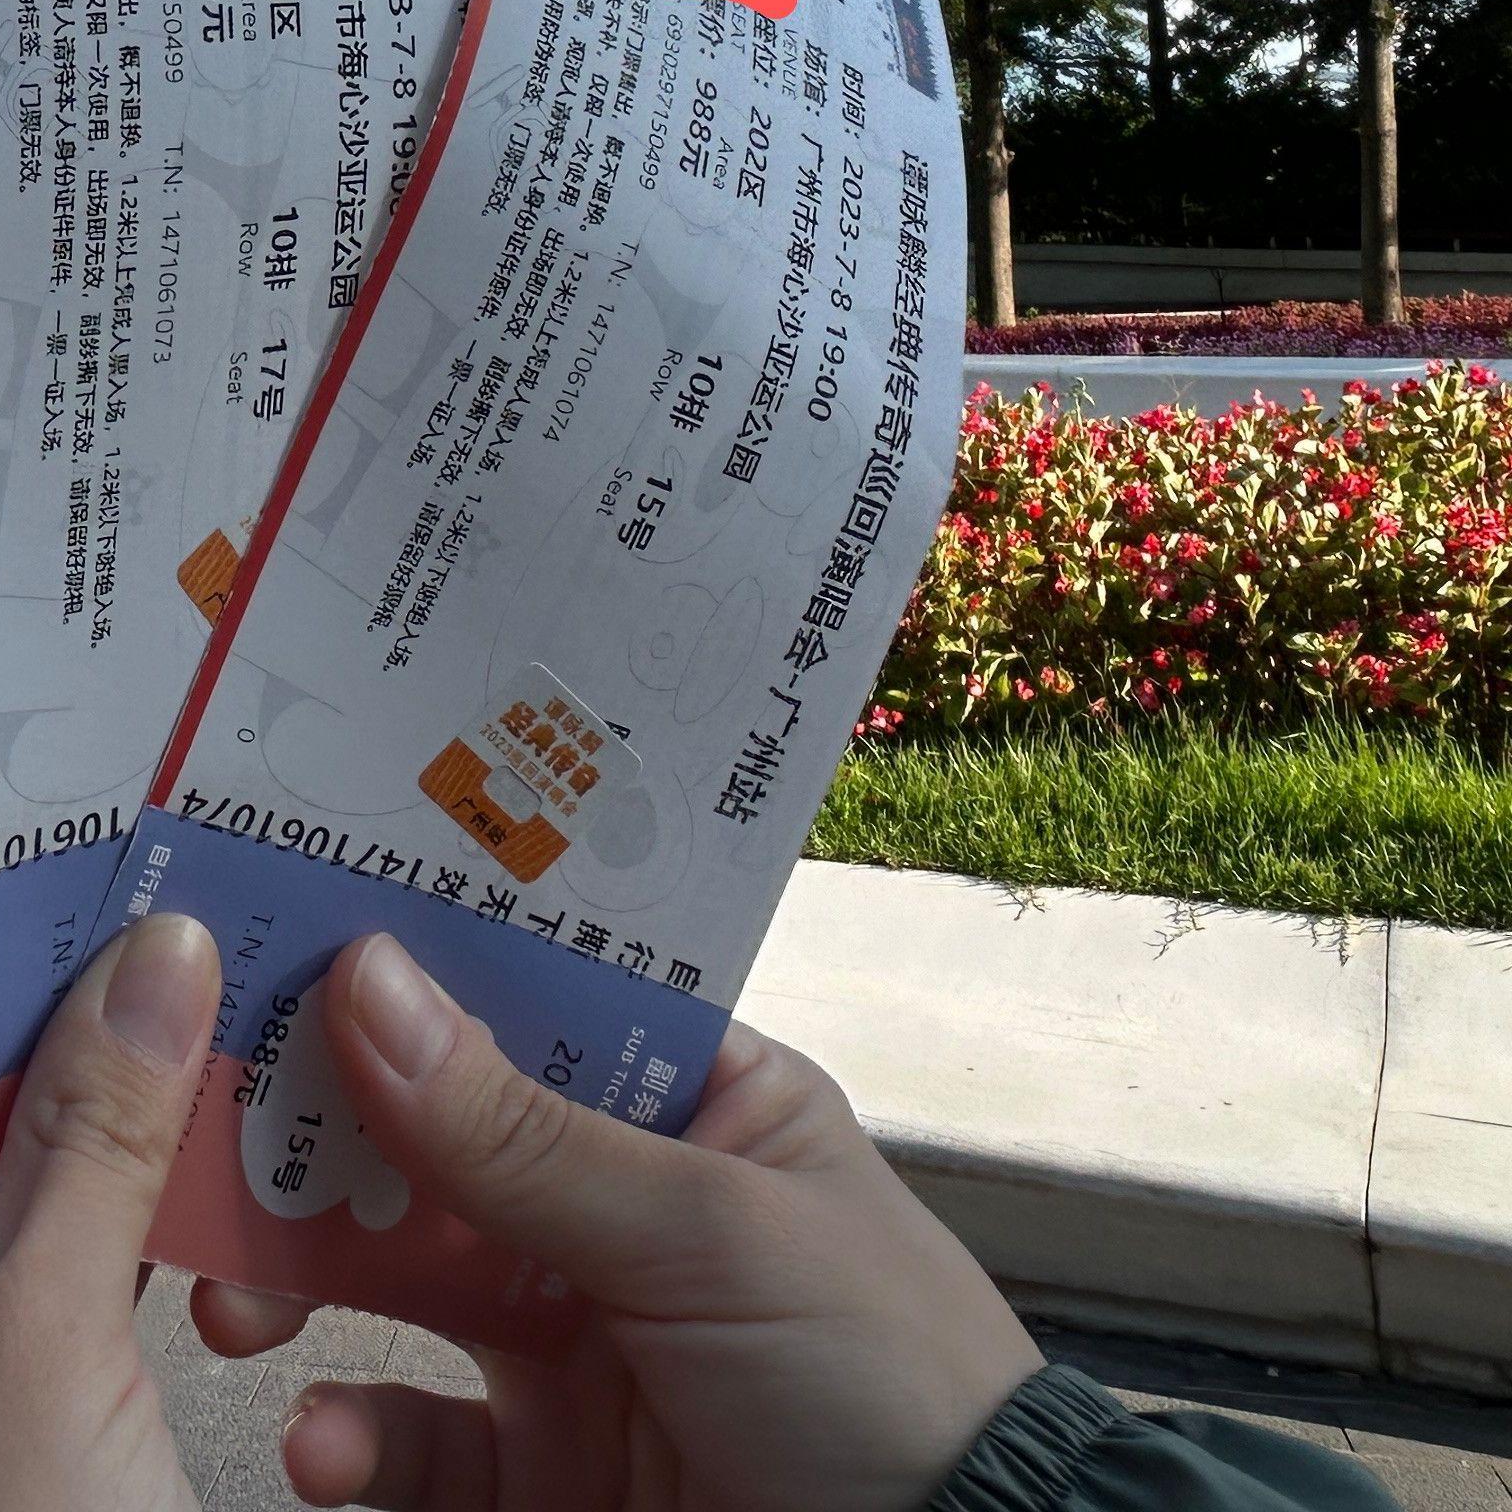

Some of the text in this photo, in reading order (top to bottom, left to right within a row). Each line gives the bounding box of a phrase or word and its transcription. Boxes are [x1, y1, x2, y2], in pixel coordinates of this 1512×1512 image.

[779, 27, 797, 100] VENUE
[161, 141, 181, 193] T.N:
[676, 77, 720, 179] 988元
[734, 106, 772, 208] 202区
[236, 223, 257, 277] Row
[262, 206, 297, 292] 10排
[540, 13, 683, 445] 6930297150499 T.N: 1471061074
[594, 0, 746, 521] SEAT Area Row Seat
[827, 155, 863, 313] 2023-7-8
[151, 210, 179, 364] 1471061073
[721, 133, 822, 484] 广州市海心沙亚运公园
[224, 351, 247, 406] Seat
[252, 338, 286, 422] 17号
[664, 348, 726, 435] 10排
[804, 322, 848, 425] 19:00
[612, 469, 674, 557] 15号
[712, 152, 923, 829] 谭咏麟经典传奇巡回演唱会-广州站
[233, 996, 300, 1108] 988元
[595, 1026, 646, 1115] SUB TICK
[626, 1056, 678, 1125] 副券
[271, 1111, 323, 1195] 15号
